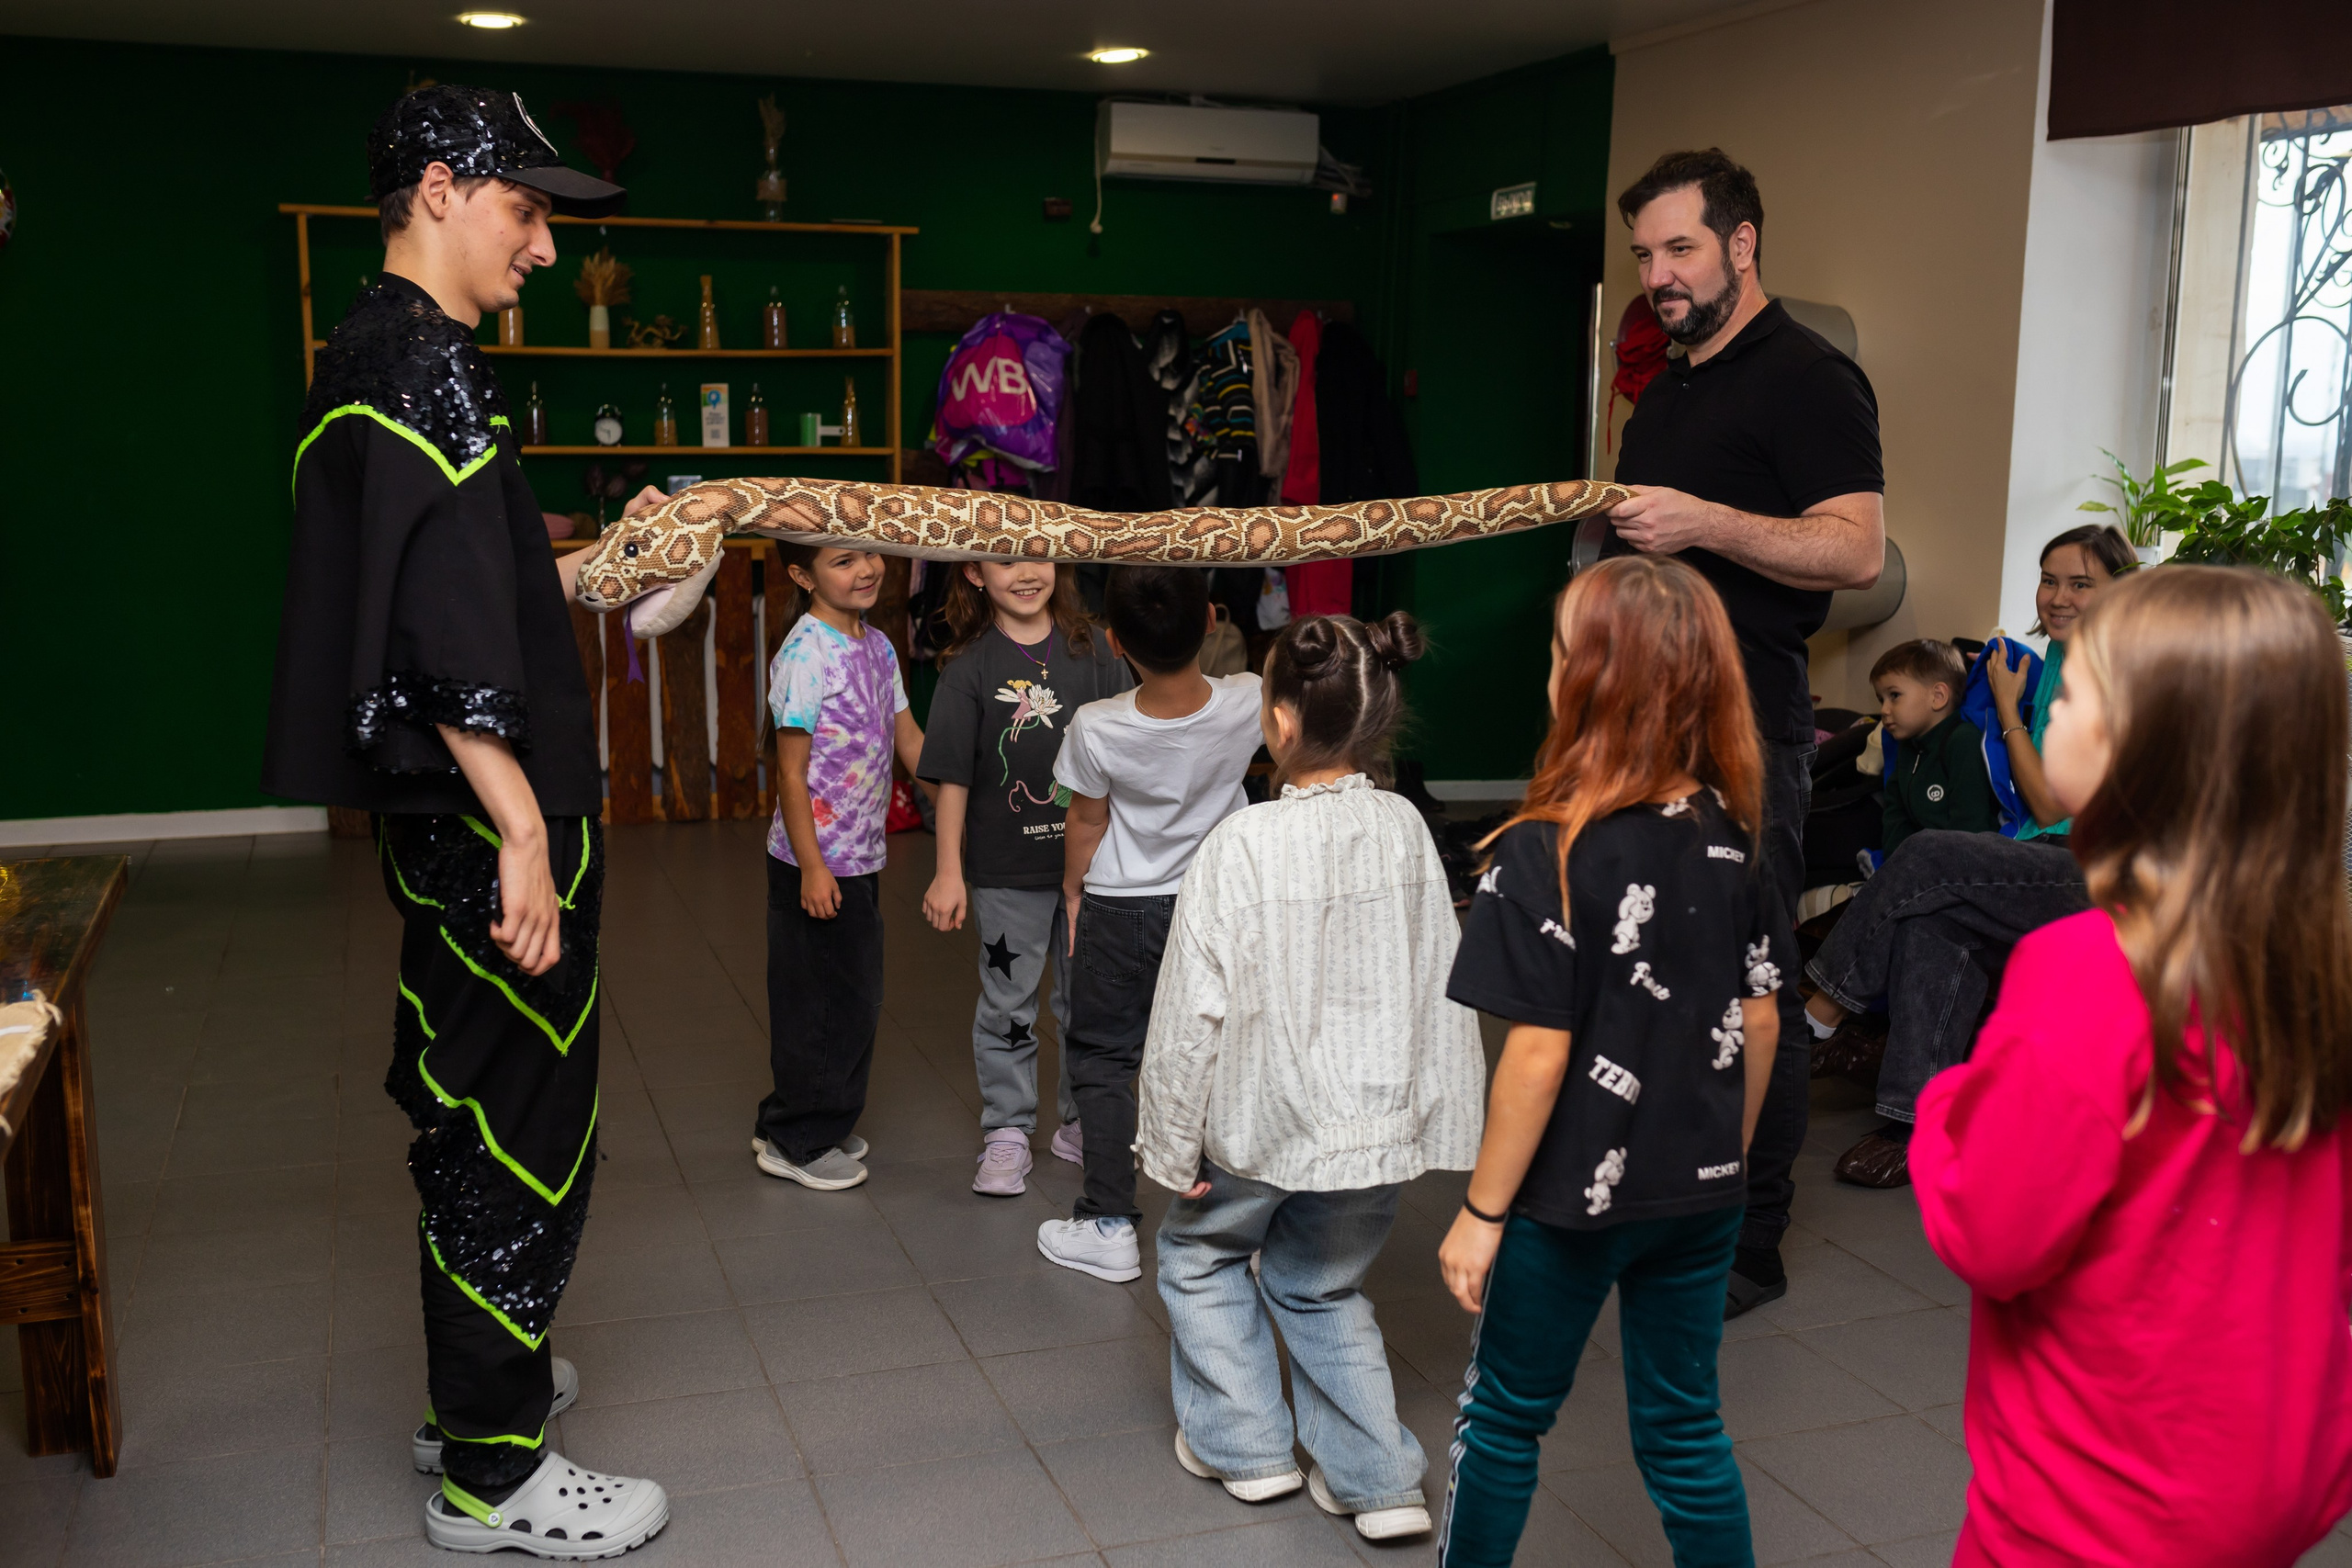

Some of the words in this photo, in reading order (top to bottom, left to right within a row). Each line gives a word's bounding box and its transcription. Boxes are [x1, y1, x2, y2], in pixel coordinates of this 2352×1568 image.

[952, 355, 1028, 401] WB
[1023, 825, 1050, 835] RAISE
[1697, 1160, 1740, 1180] MICKEY
